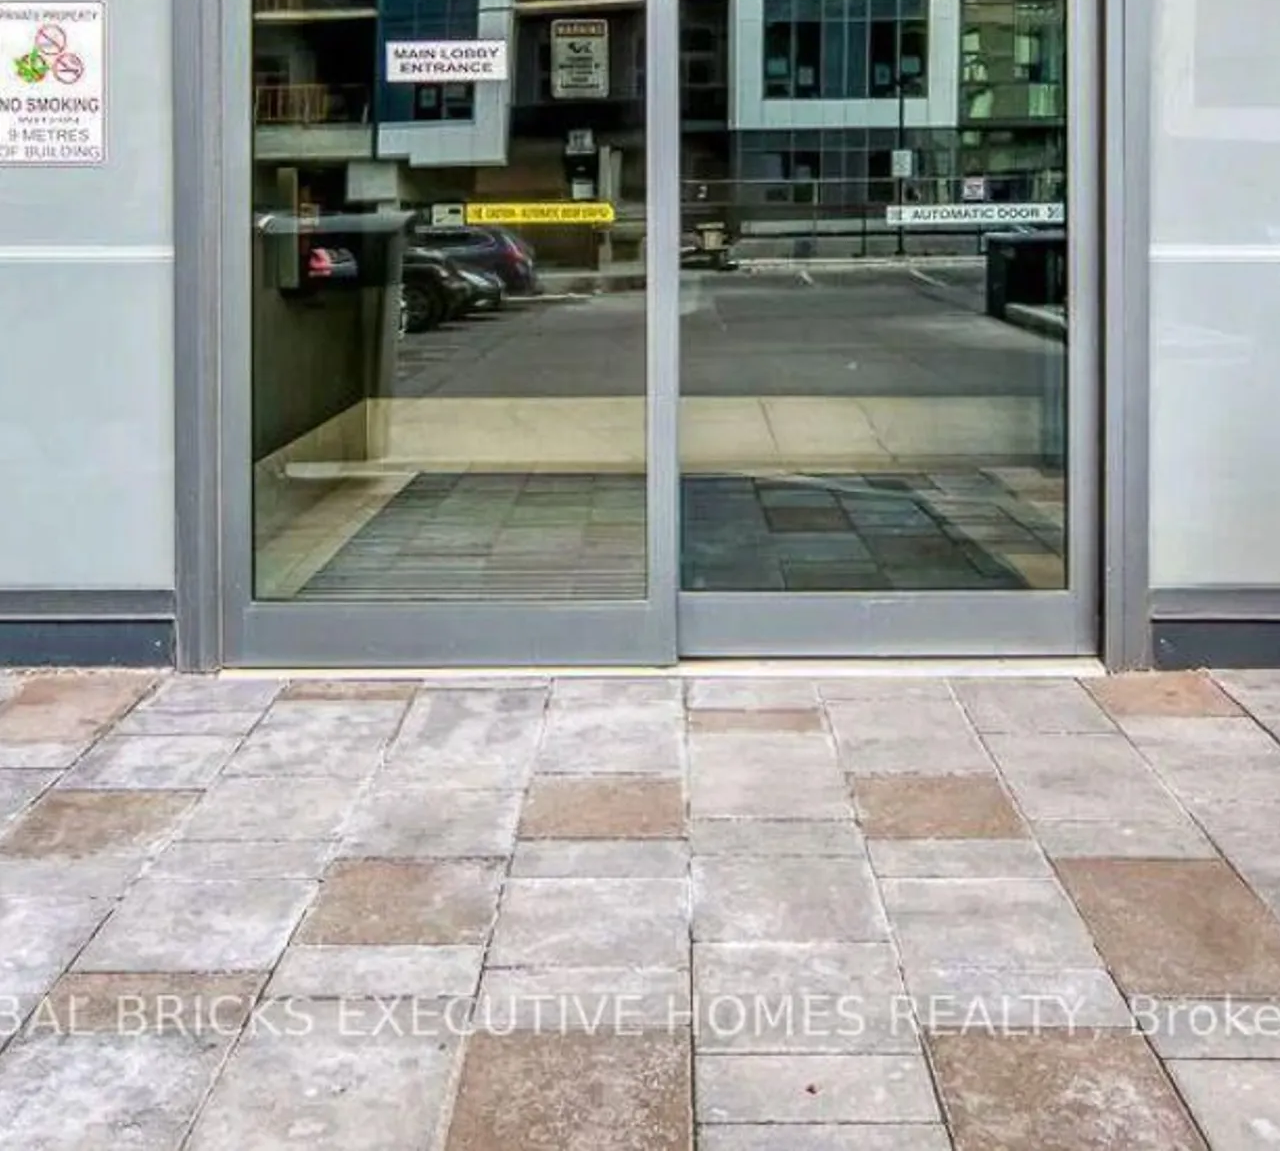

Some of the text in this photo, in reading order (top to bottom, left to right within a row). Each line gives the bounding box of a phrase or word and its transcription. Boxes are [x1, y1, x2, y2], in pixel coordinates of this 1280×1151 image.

[393, 46, 500, 59] MAIN LOBBY
[399, 60, 494, 73] ENTRANCE
[25, 98, 100, 114] SMOKING
[7, 128, 90, 143] 9 METRES
[23, 145, 101, 159] BUILDING
[910, 206, 1041, 220] AUTOMATIC DOOR
